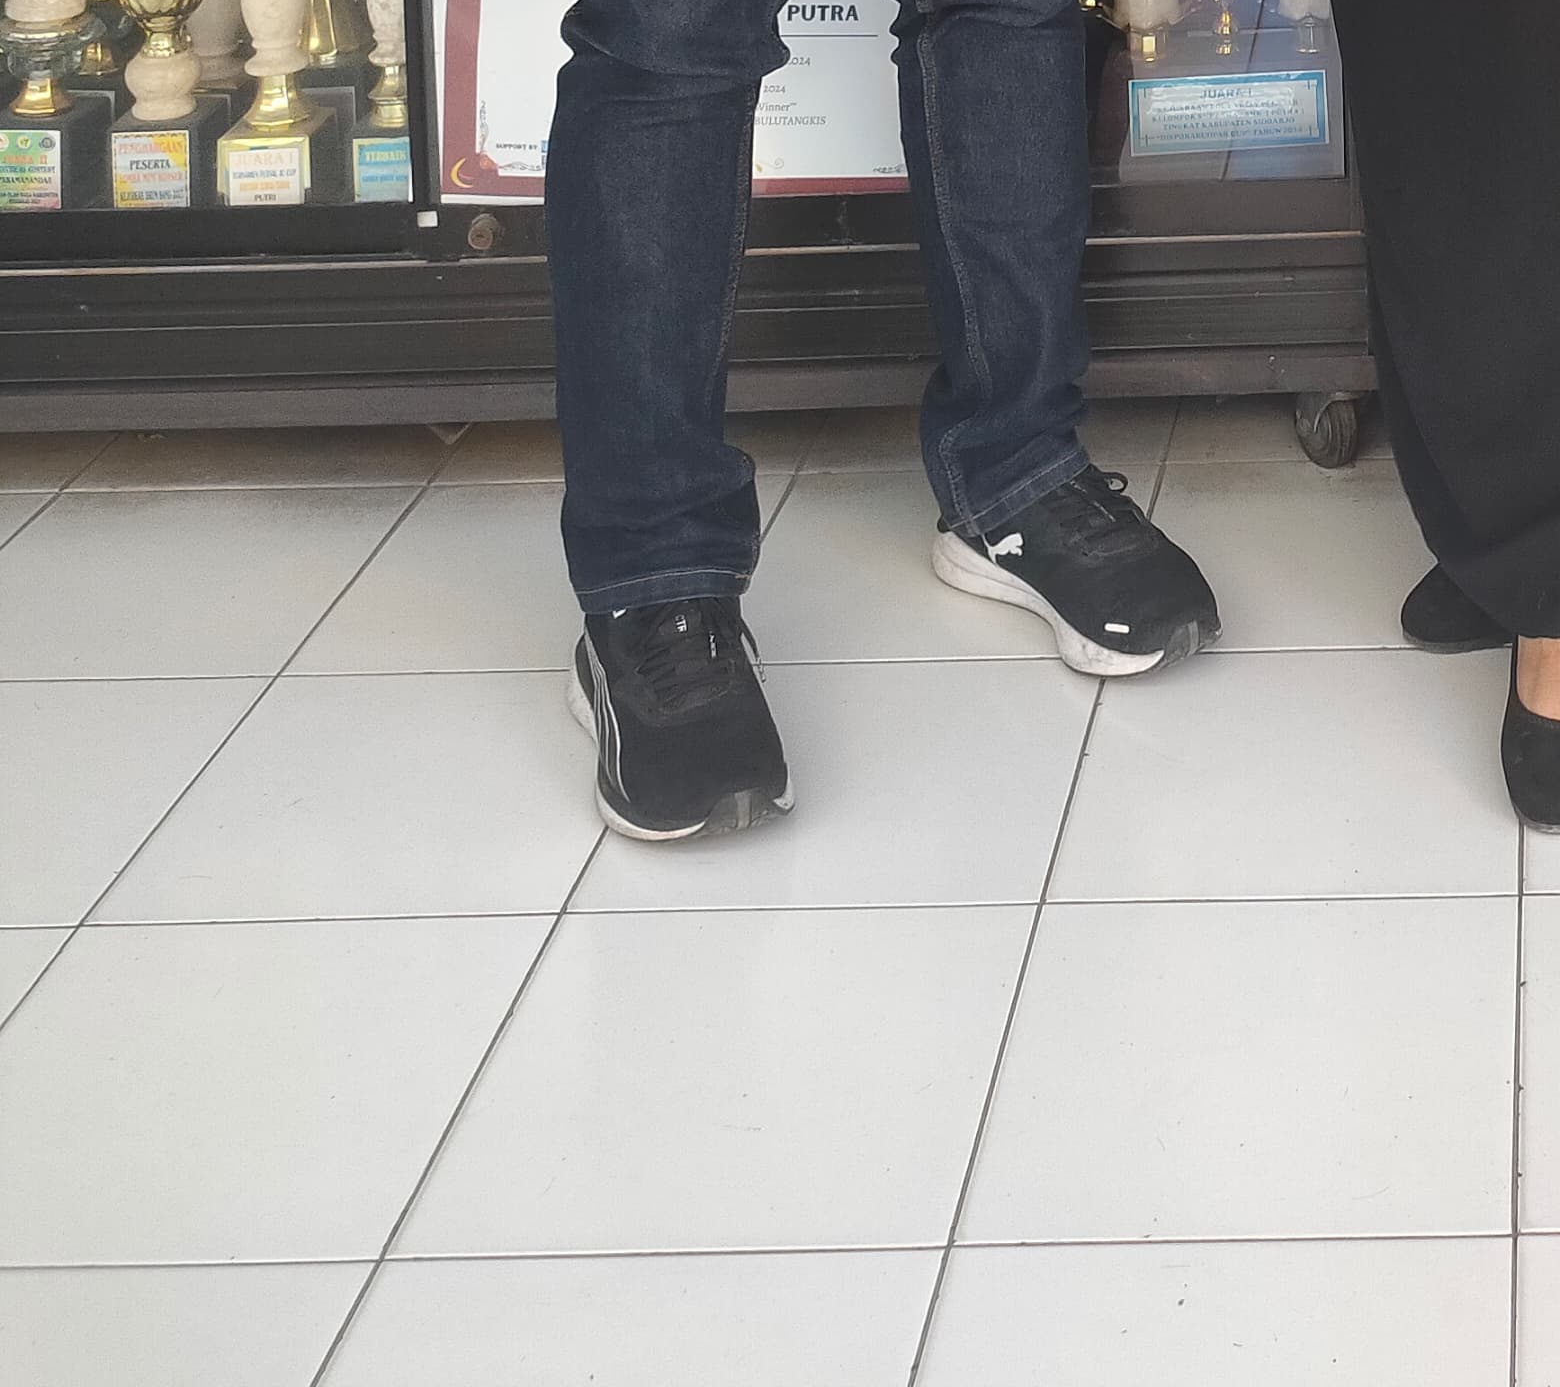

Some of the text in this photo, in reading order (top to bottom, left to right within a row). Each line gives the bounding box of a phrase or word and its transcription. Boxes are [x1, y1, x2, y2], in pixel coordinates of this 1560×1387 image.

[787, 4, 860, 22] PUTRA
[763, 85, 786, 94] 2024
[1200, 89, 1242, 100] JUARA
[130, 159, 171, 170] PESERTA
[237, 153, 284, 166] JUARA
[254, 193, 277, 202] PUTRI
